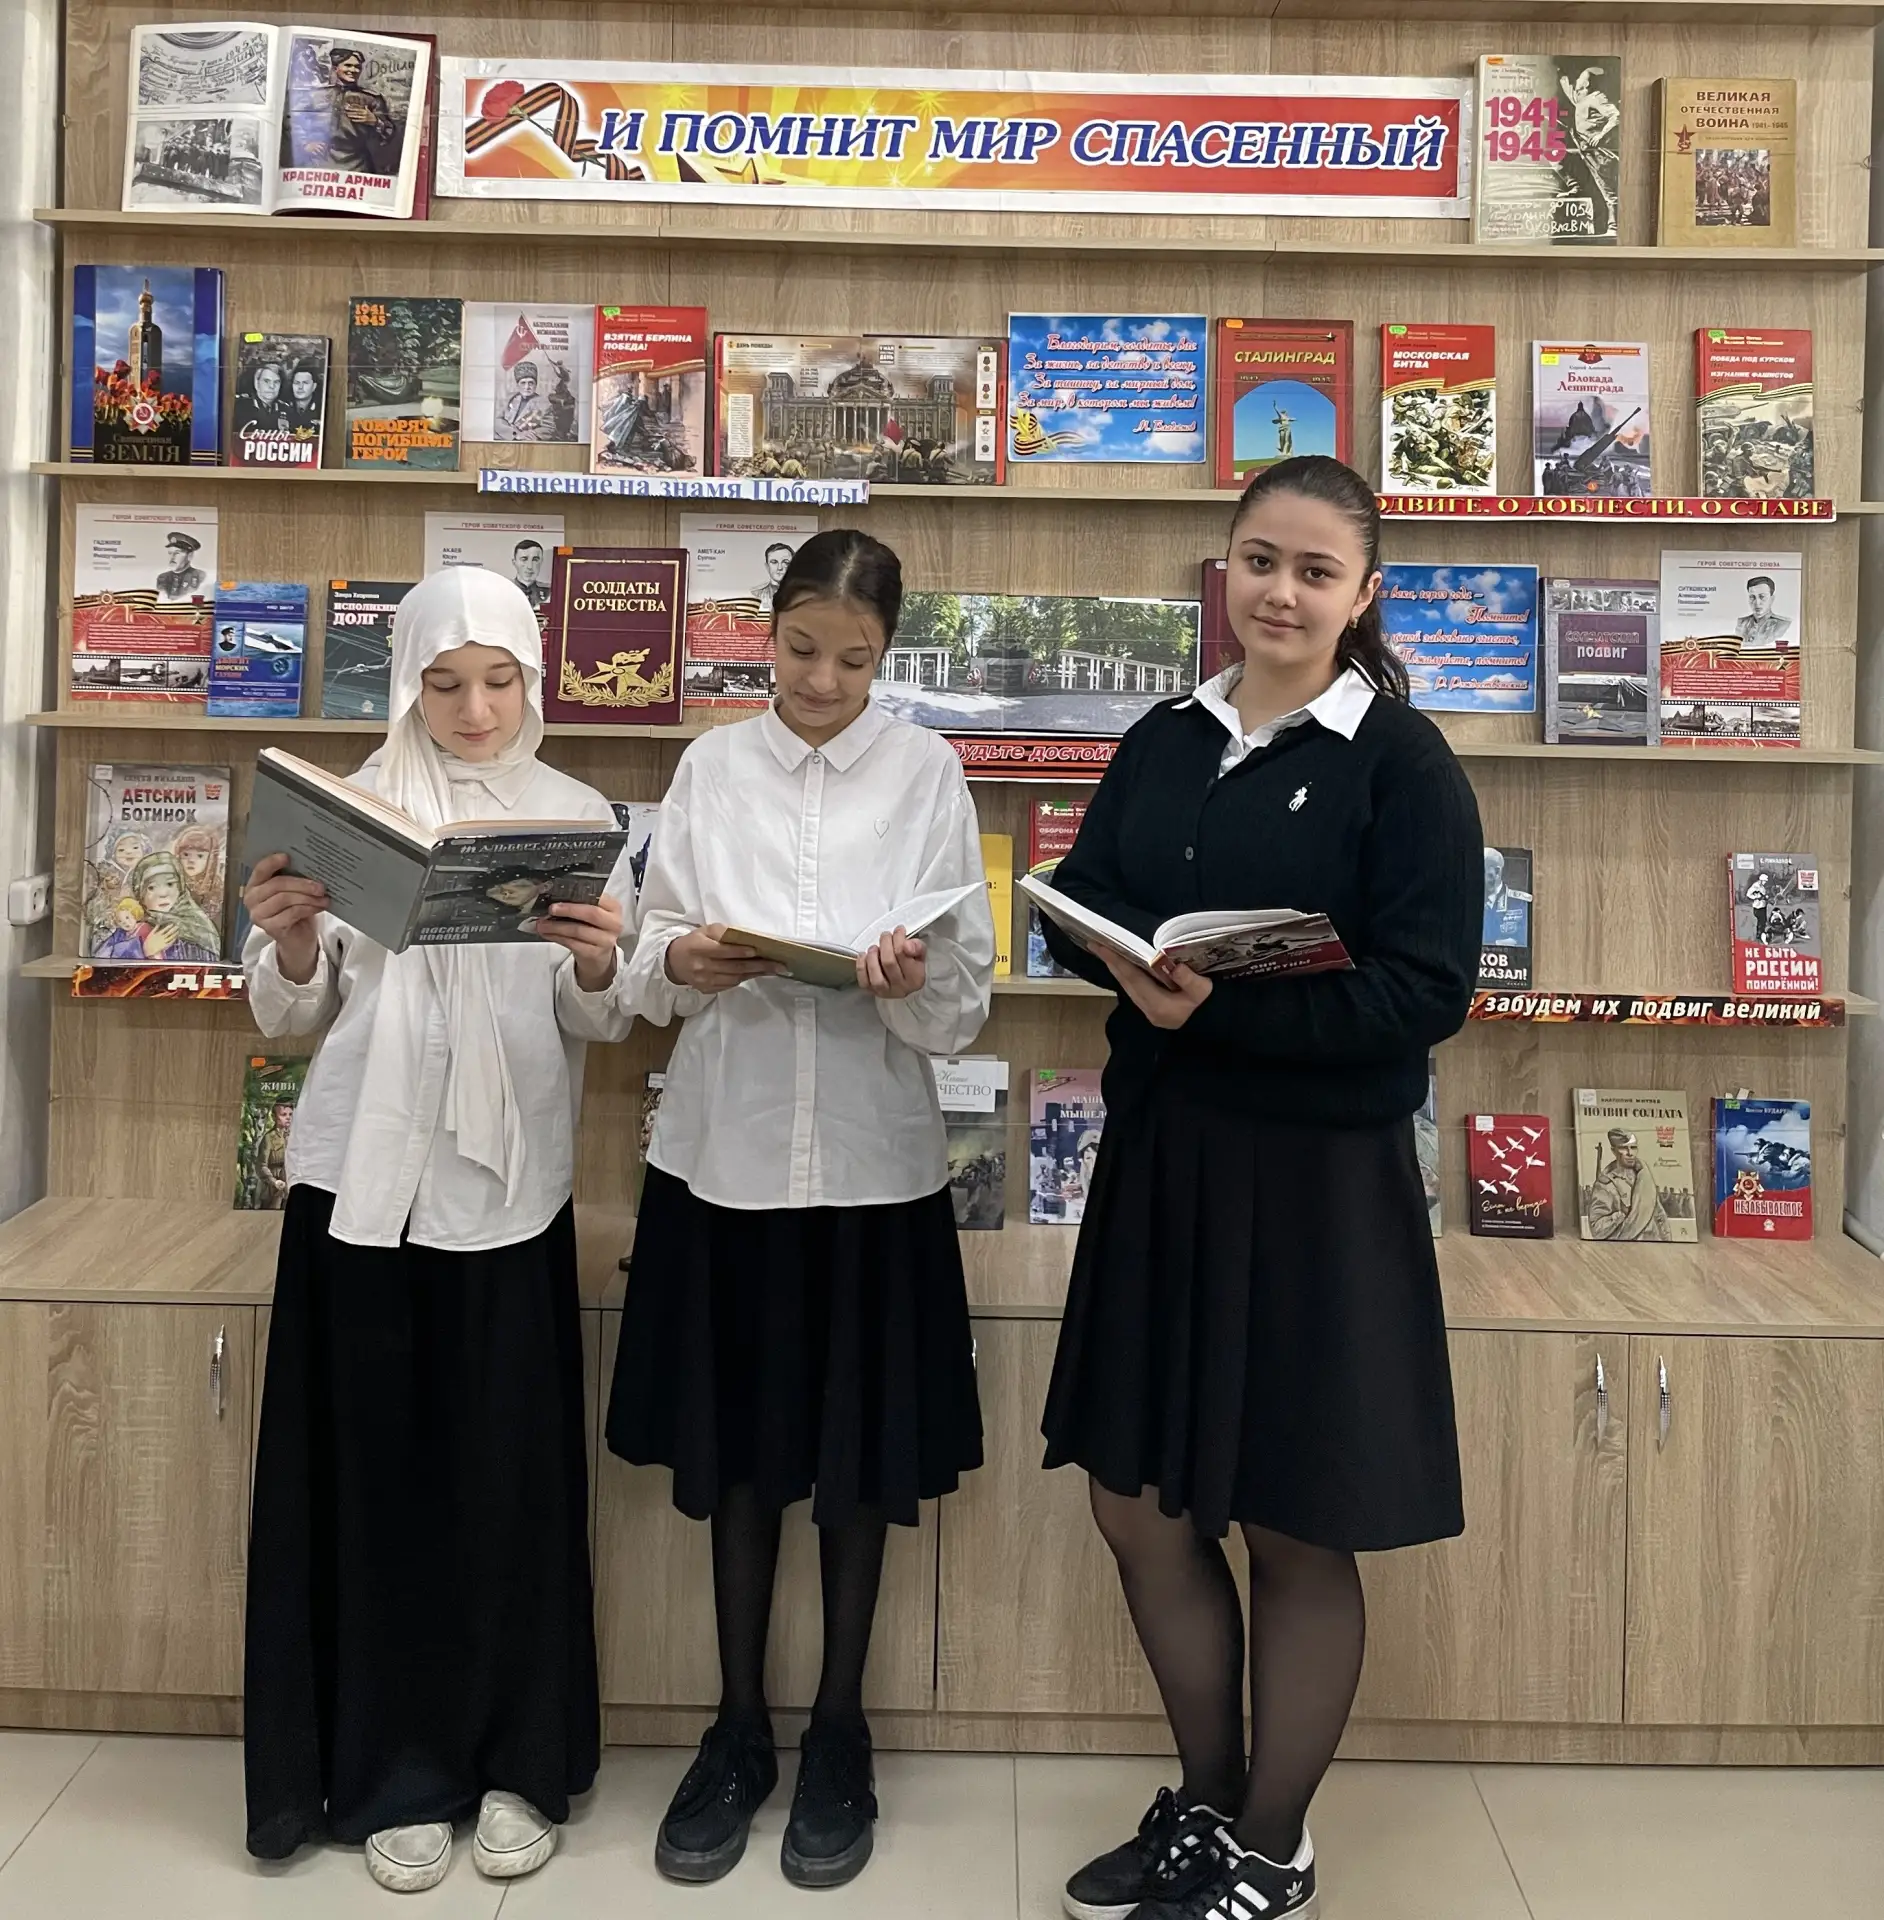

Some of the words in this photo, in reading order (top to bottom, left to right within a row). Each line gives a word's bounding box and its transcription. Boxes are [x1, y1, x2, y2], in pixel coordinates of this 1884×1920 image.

[1697, 92, 1771, 102] ВЕЛИКАЯ
[1680, 106, 1780, 115] ОТЕЧЕСТВЕННАЯ
[599, 112, 645, 152] И
[659, 113, 915, 160] ПОМНИТ
[928, 119, 1060, 162] МИР
[1073, 114, 1447, 168] СПАСЕННЫЙ
[1484, 130, 1567, 162] 1945
[282, 170, 340, 184] КРАСНОЙ
[345, 174, 391, 189] АРМИИ
[604, 333, 643, 342] ВЗЯТИЕ
[646, 334, 692, 343] БЕРЛИНА
[604, 342, 648, 351] ПОБЕДА!
[1234, 351, 1336, 364] СТАЛИНГРАД
[1393, 351, 1470, 360] МОСКОВСКАЯ
[1568, 372, 1613, 384] Блокада
[1557, 381, 1624, 394] Ленинграда
[239, 420, 290, 441] Сыны
[353, 418, 431, 432] ГОВОРЯТ
[353, 433, 453, 447] ПОГИБШИЕ
[103, 444, 180, 462] ЗЕМЛЯ
[244, 441, 313, 462] РОССИИ
[353, 447, 408, 460] ГЕРОИ
[481, 470, 613, 495] Равнение
[618, 478, 650, 496] на
[660, 480, 742, 498] знамя
[751, 479, 868, 507] Победы!
[1497, 497, 1519, 513] О
[1526, 498, 1693, 516] ДОБЛЕСТИ,
[1700, 500, 1722, 515] О
[582, 581, 661, 595] СОЛДАТЫ
[573, 598, 667, 613] ОТЕЧЕСТВА
[333, 612, 379, 625] ДОЛГ
[1565, 630, 1640, 643] СОЛДАТСКИЙ
[1577, 646, 1628, 659] ПОДВИГ
[953, 742, 1024, 761] будьте
[122, 786, 197, 804] ДЕТСКИЙ
[121, 808, 197, 823] БОТИНОК
[1745, 947, 1760, 958] НЕ
[1765, 948, 1797, 959] БЫТЬ
[1746, 961, 1818, 977] РОССИИ
[1746, 977, 1819, 991] ПОКОРЁННОЙ!
[1485, 995, 1580, 1016] забудем
[1592, 1001, 1620, 1015] их
[1630, 1001, 1713, 1019] подвиг
[1722, 1001, 1821, 1019] великий
[1584, 1107, 1630, 1117] ПОДВИГ
[1633, 1108, 1683, 1118] СОЛДАТА
[1735, 1200, 1803, 1216] НЕЗАБЫВАЕМОЕ
